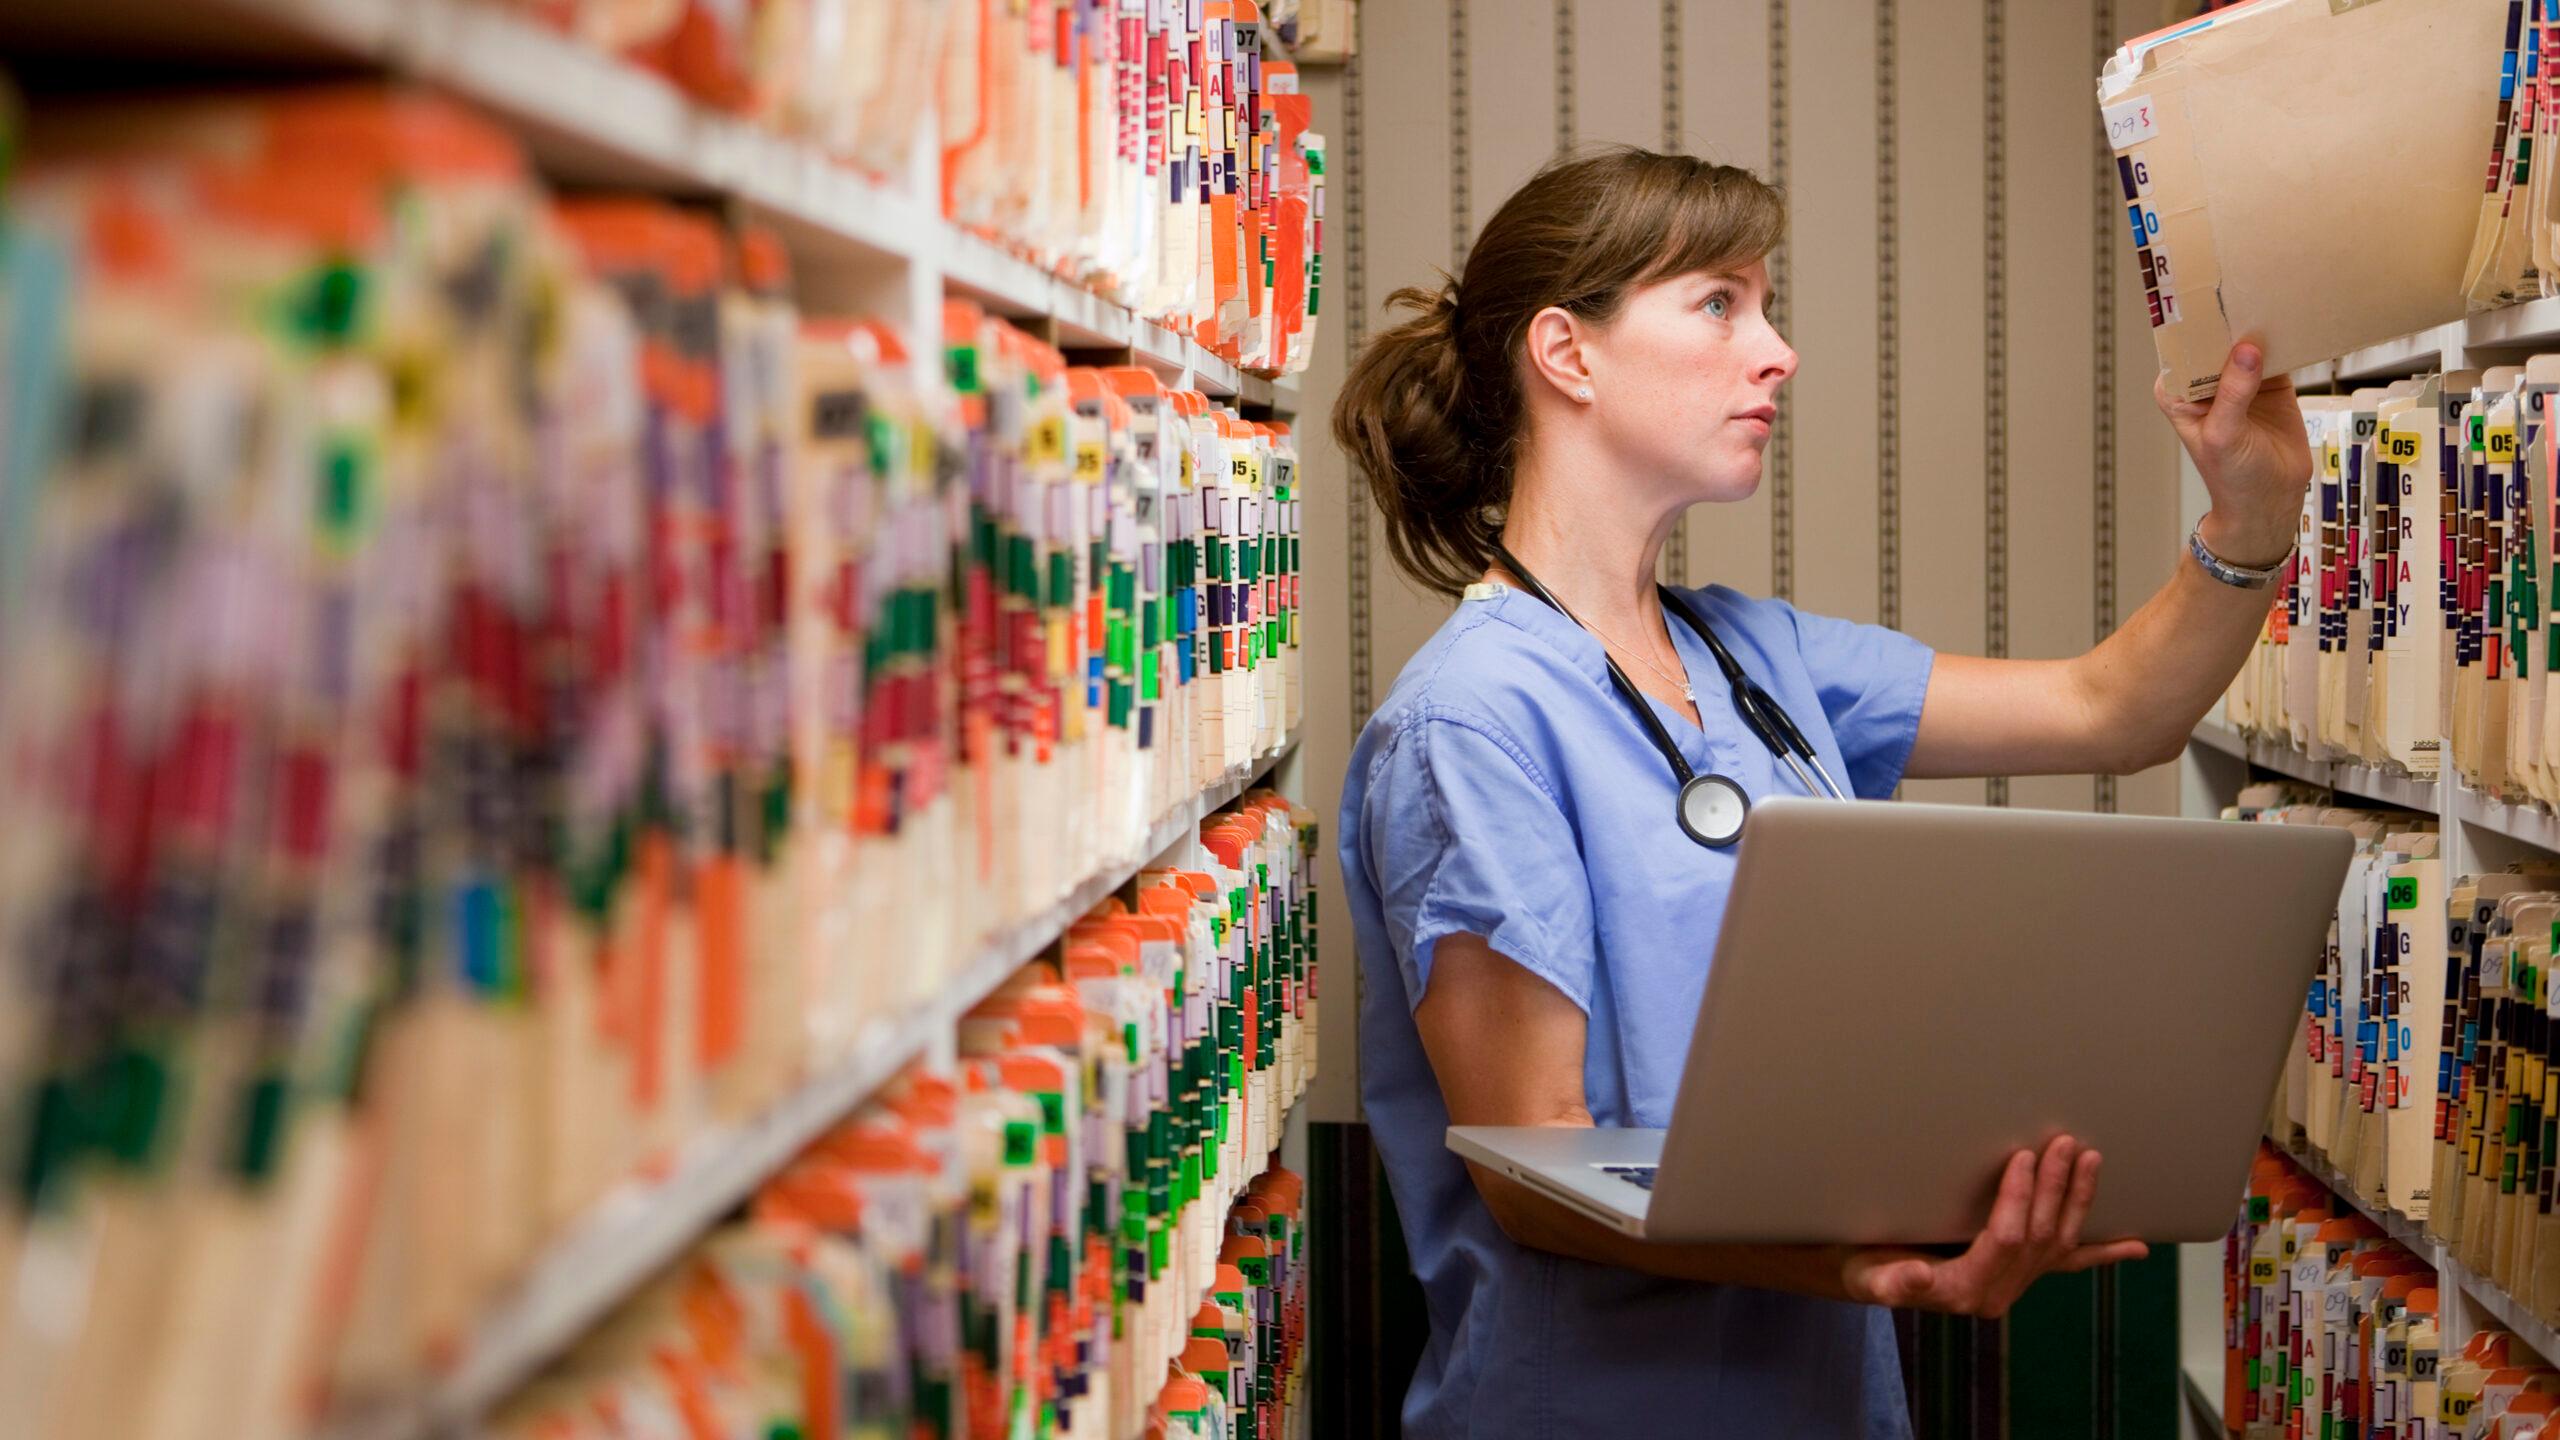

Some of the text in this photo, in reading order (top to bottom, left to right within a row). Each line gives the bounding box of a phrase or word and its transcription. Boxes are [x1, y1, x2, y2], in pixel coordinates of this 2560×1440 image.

[1237, 31, 1256, 46] 07
[2134, 162, 2174, 313] GORT
[2356, 419, 2377, 436] 07
[2393, 440, 2415, 456] 05
[2492, 435, 2512, 452] 05
[2399, 474, 2414, 626] GRAY
[2391, 885, 2412, 903] 06
[2400, 932, 2411, 1097] GROV
[2254, 1263, 2272, 1276] 05
[2298, 1265, 2319, 1282] 09
[2325, 1291, 2346, 1312] 09
[2304, 1300, 2315, 1435] HADL
[2415, 1357, 2437, 1374] 07
